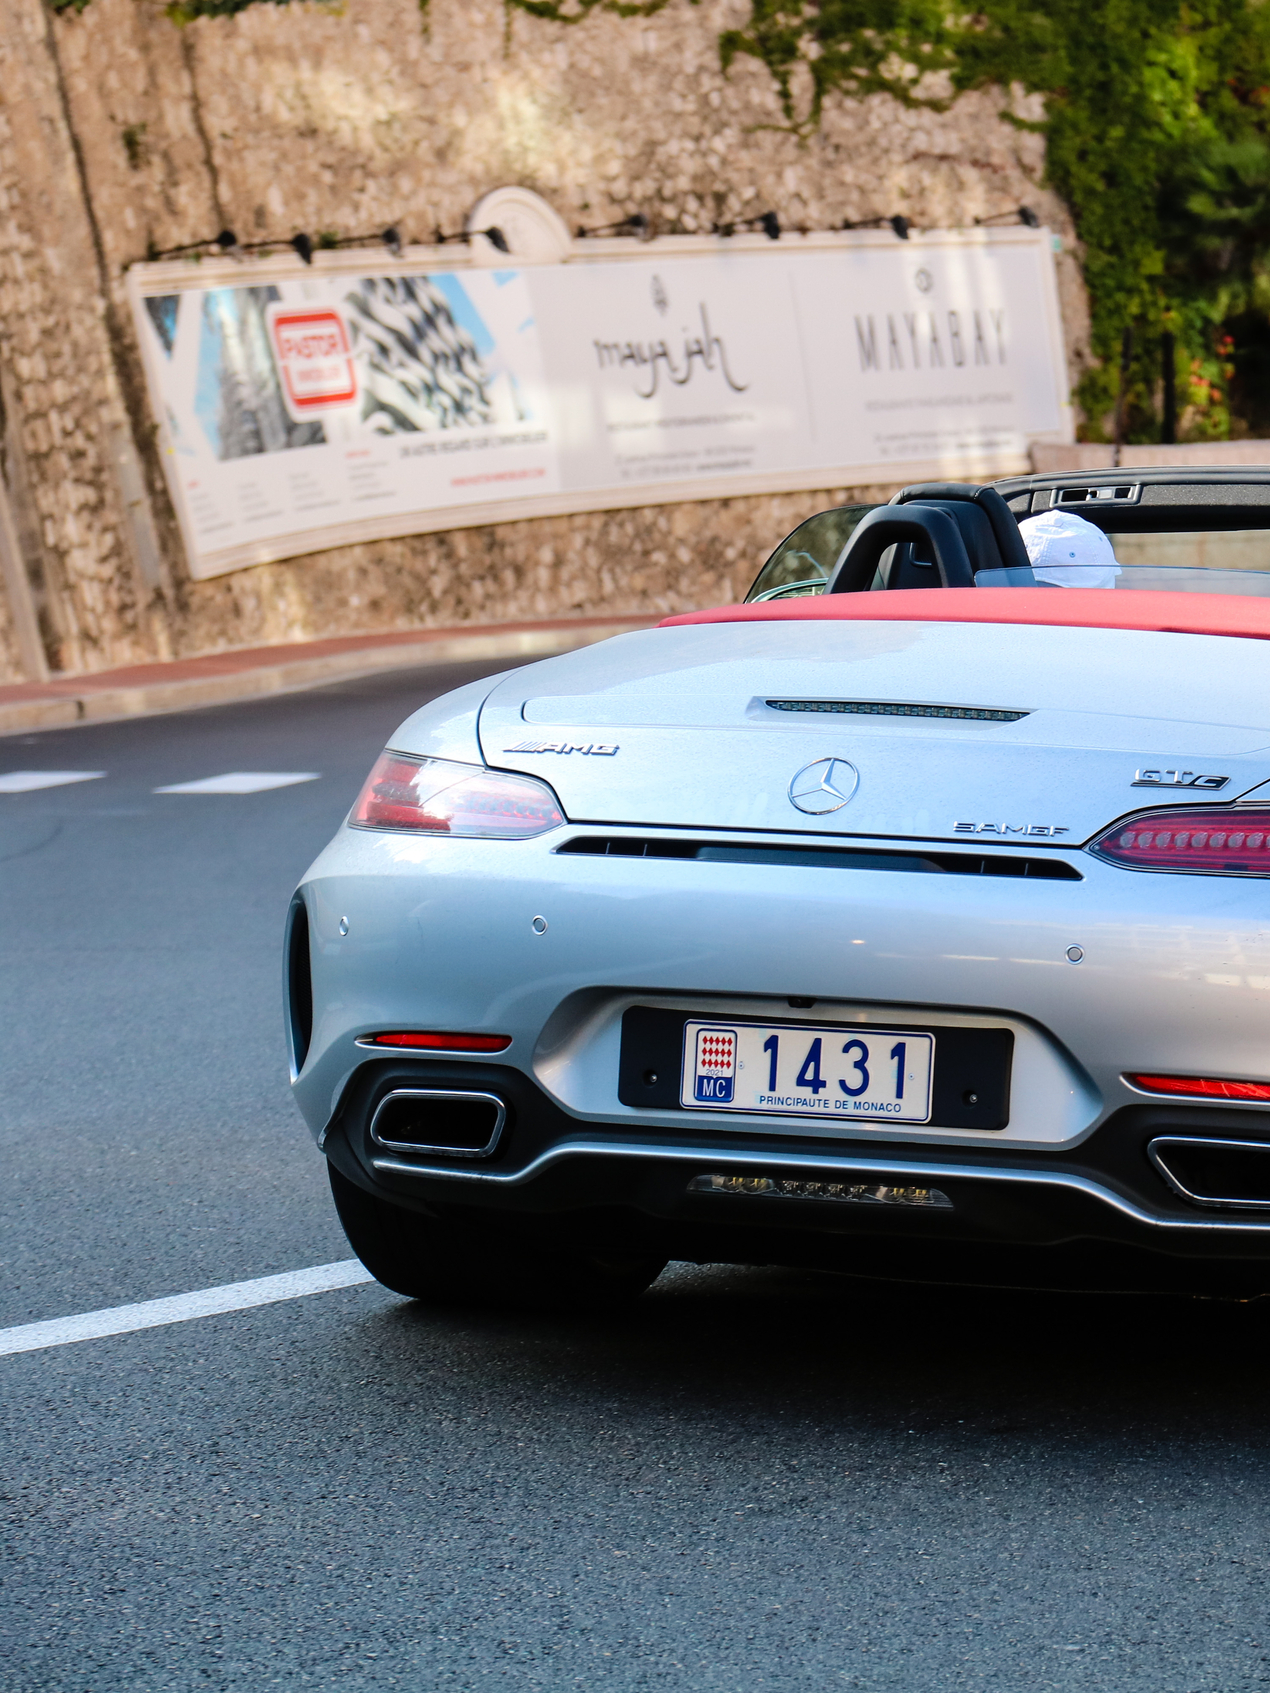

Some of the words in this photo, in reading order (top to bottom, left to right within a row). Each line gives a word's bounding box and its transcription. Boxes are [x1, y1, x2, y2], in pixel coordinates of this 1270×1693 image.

[282, 333, 340, 360] PASTOR
[855, 310, 1007, 372] MAYABAY
[536, 740, 620, 756] AMG
[705, 1068, 724, 1076] 2021
[763, 1034, 907, 1100] 1431
[702, 1078, 726, 1098] MC
[759, 1095, 830, 1109] PRINCIPAUTE
[834, 1099, 849, 1111] DE
[853, 1101, 902, 1113] MONACO
